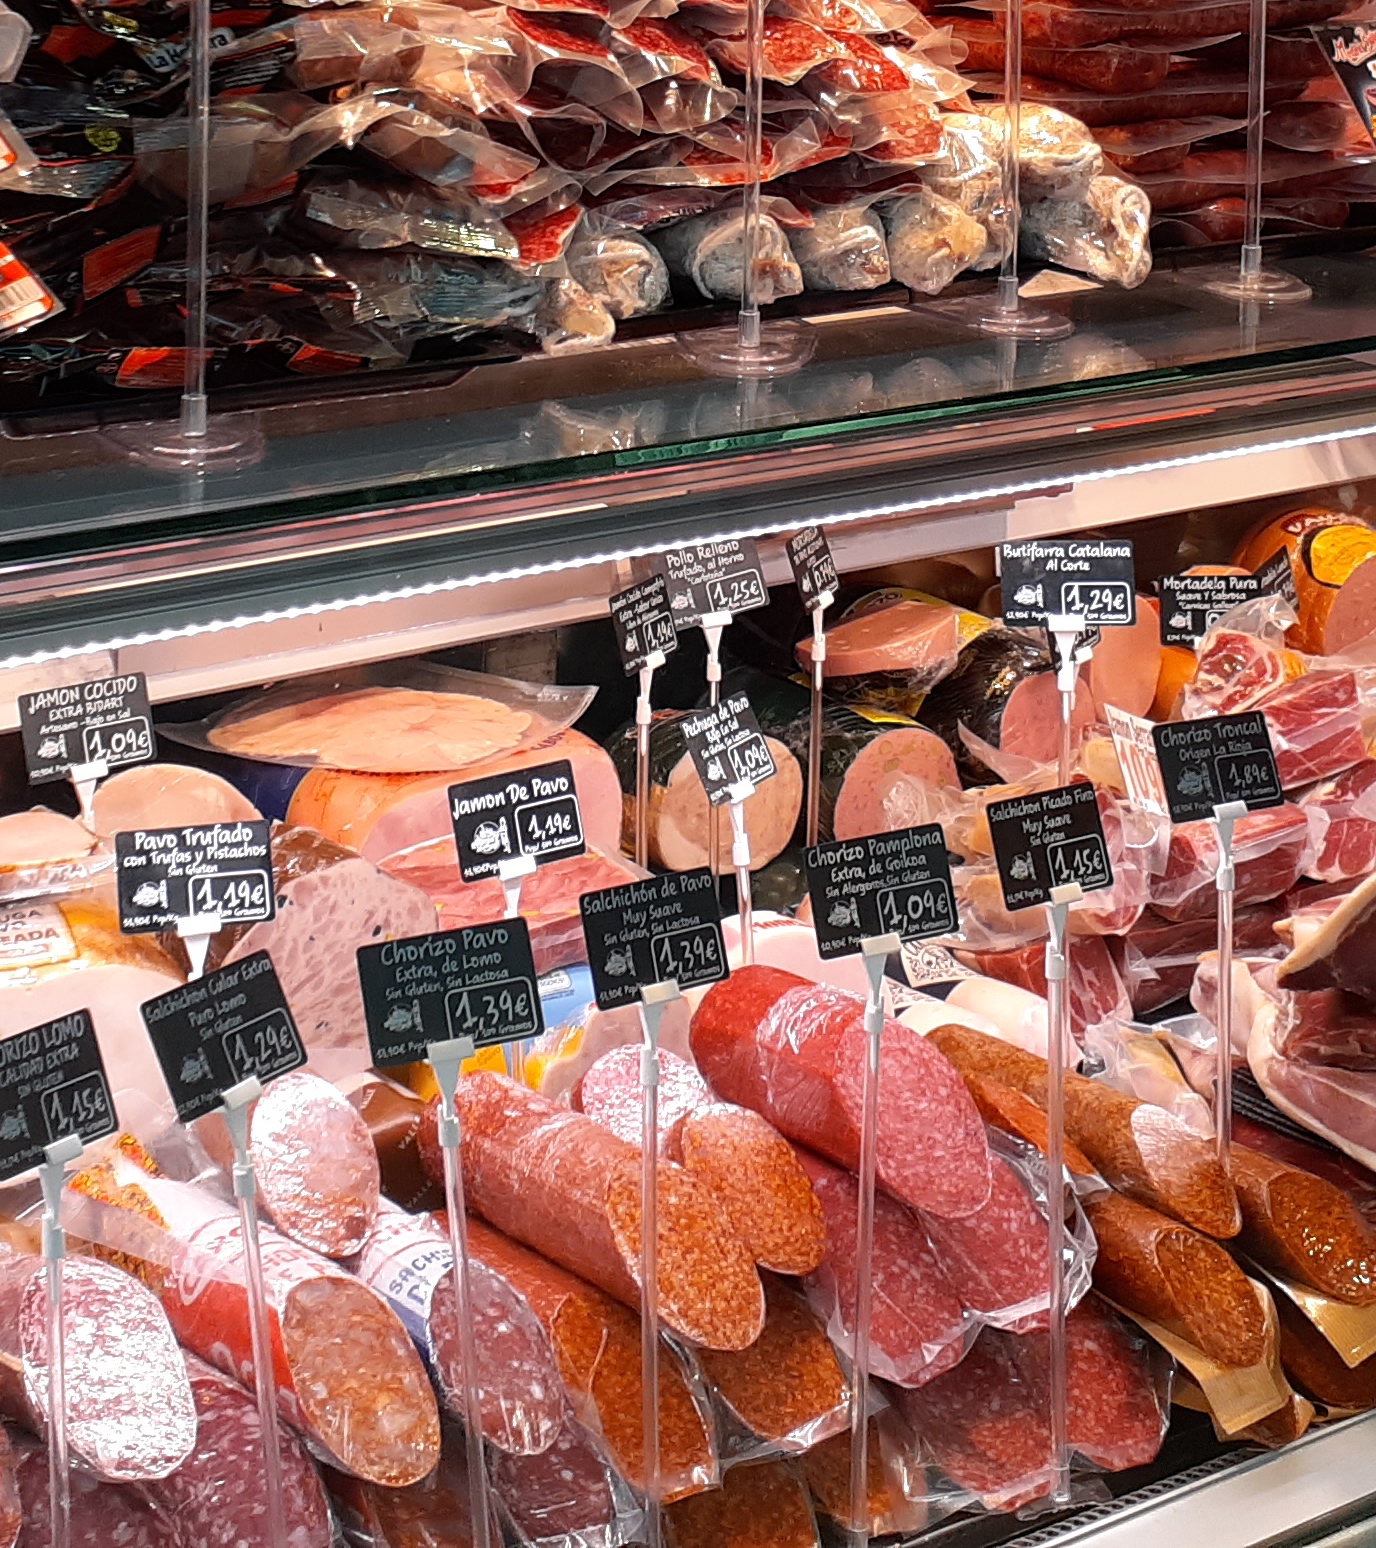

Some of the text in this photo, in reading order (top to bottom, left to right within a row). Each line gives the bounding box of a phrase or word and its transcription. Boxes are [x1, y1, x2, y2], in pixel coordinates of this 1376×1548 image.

[1003, 541, 1131, 562] Butifarra Catalana
[1066, 585, 1125, 615] 1,29€
[28, 676, 138, 715] JAMON COCIDO
[453, 776, 569, 821] Jamon De Pavo
[134, 822, 254, 851] Pavo Trufado
[807, 830, 943, 870] Chorizo Pamplona
[197, 878, 265, 912] 1,19€
[583, 873, 713, 916] Salchichón de Pavo
[882, 890, 949, 929] 1,09€
[381, 927, 509, 966] Chorizo Pavo
